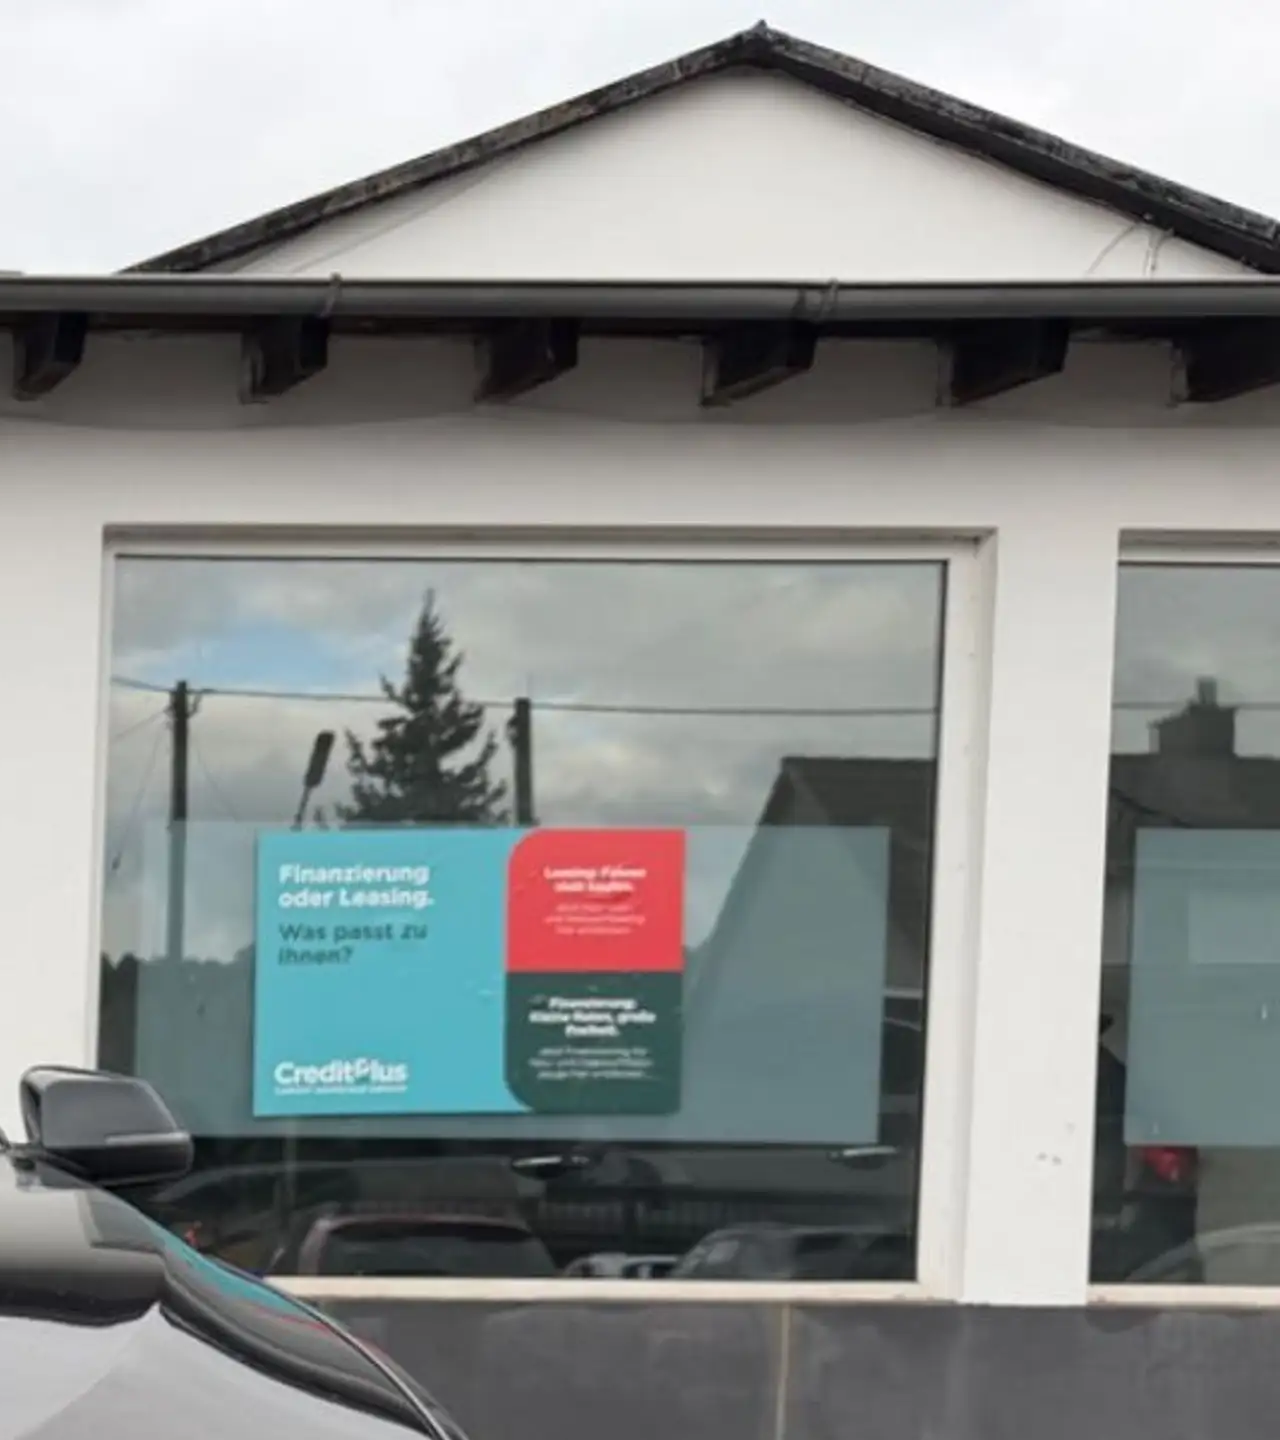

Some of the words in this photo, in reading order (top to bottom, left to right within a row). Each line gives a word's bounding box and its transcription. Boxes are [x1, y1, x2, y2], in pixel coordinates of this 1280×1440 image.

[279, 864, 430, 886] Finanzierung
[278, 888, 333, 908] oder
[339, 887, 436, 910] Leasing.
[278, 923, 326, 941] Was
[333, 923, 393, 944] passt
[399, 923, 428, 940] zu
